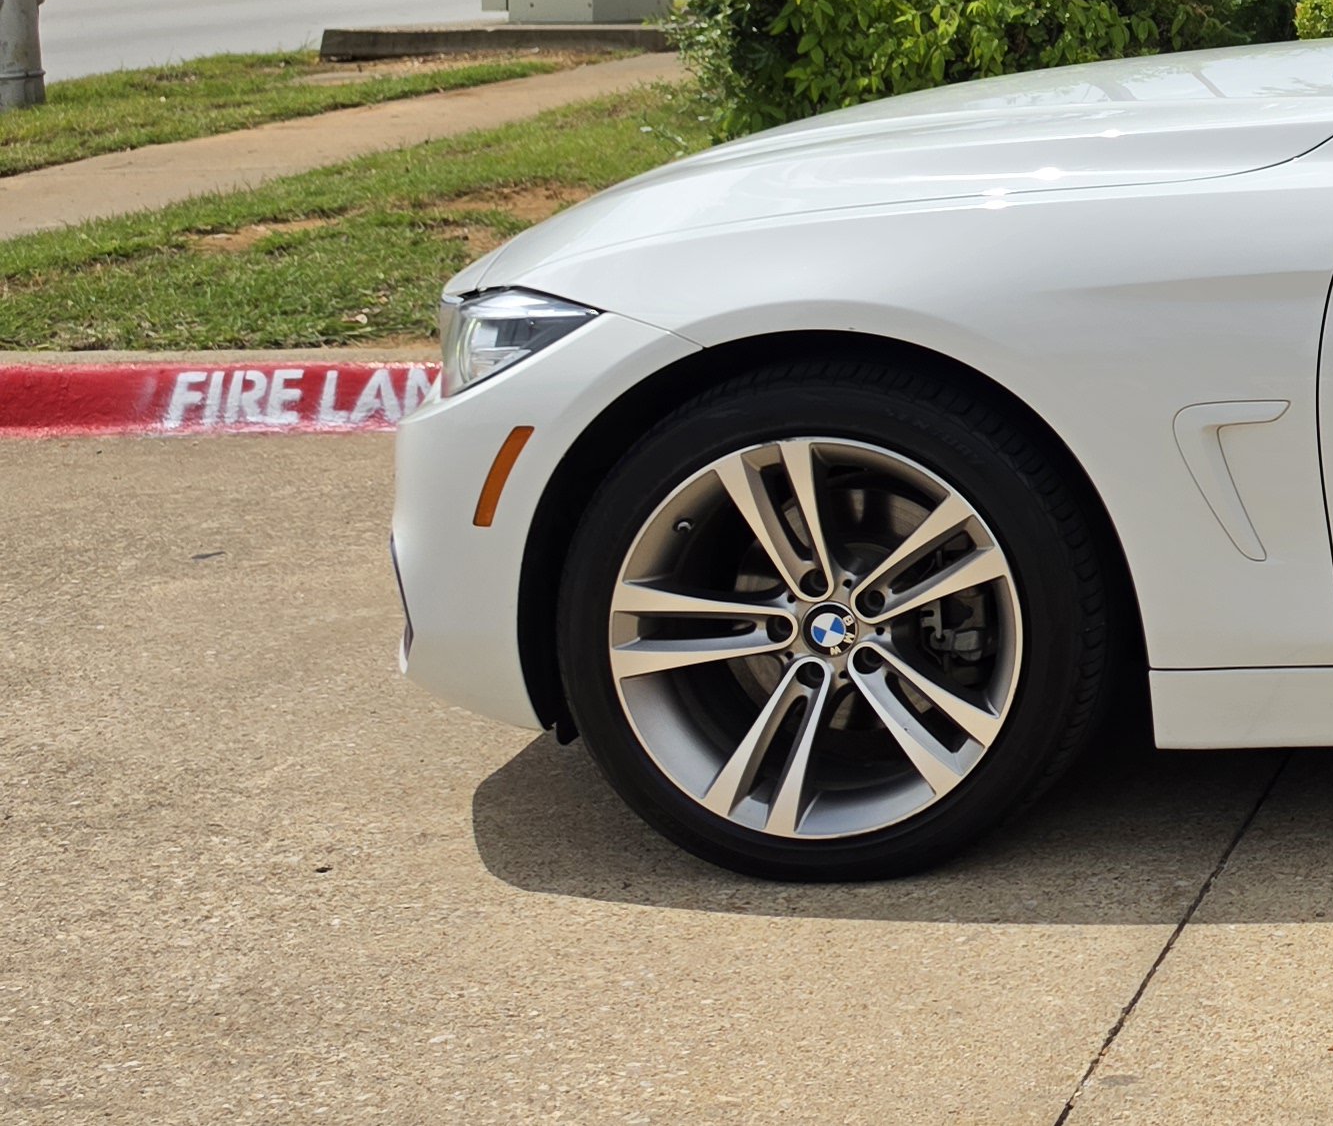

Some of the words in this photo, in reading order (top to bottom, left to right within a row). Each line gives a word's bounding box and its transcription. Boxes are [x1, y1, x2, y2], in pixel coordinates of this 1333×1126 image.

[162, 369, 305, 428] FIRE
[317, 367, 433, 427] LAN
[829, 615, 856, 656] BMW
